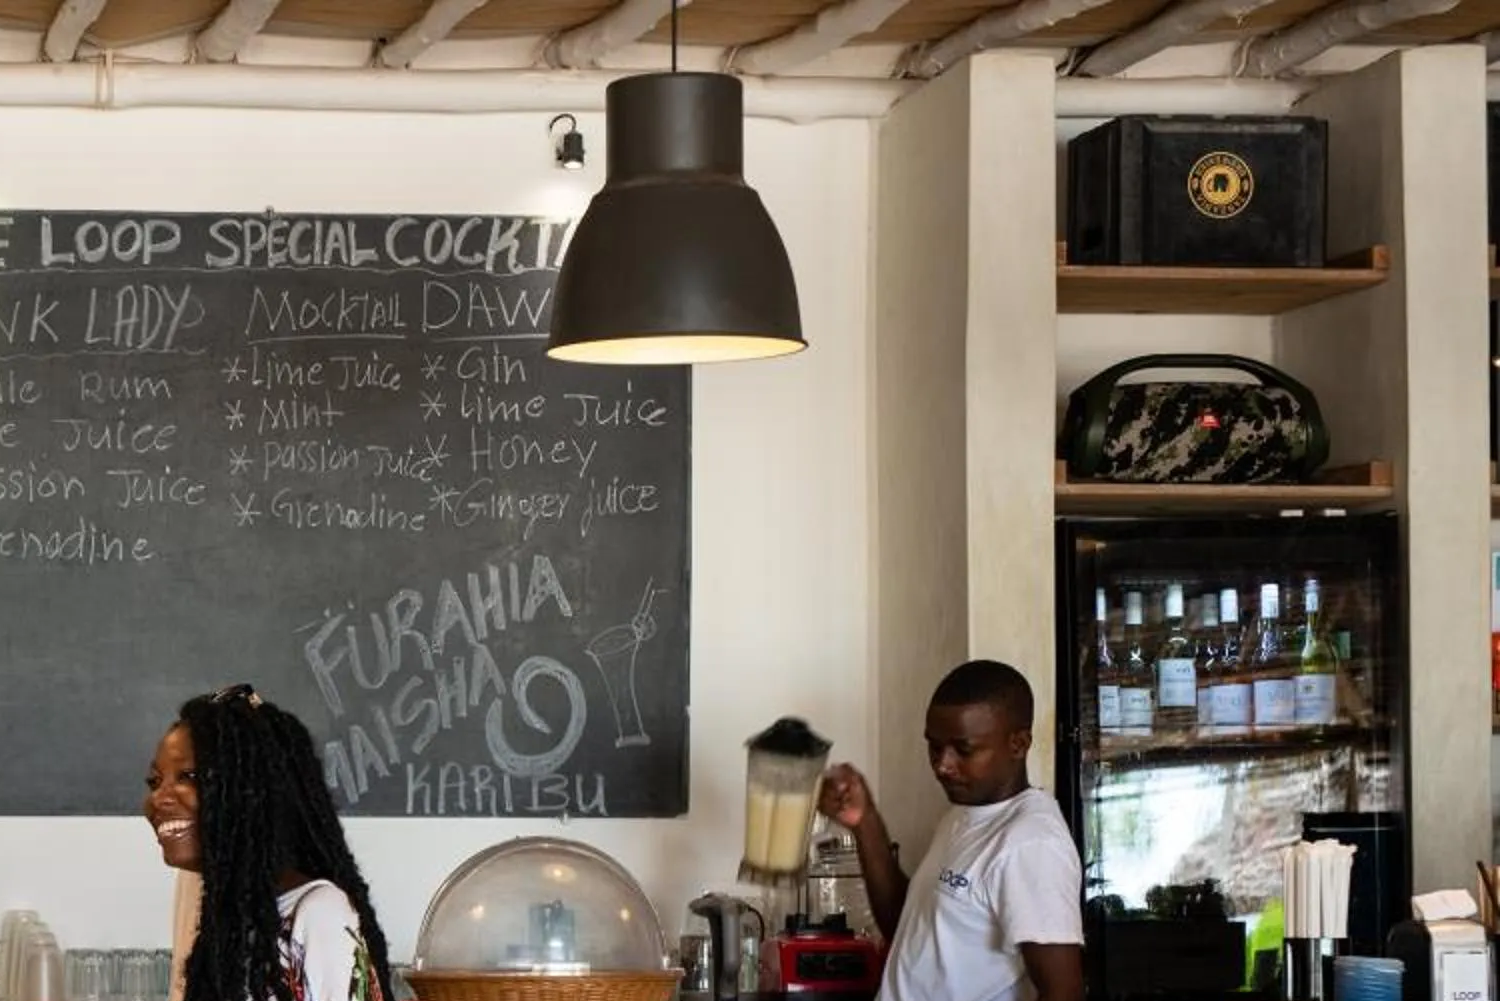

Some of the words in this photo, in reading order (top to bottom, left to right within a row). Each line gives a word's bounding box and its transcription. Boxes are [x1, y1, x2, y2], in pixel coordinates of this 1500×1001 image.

[41, 217, 181, 267] LOOP
[205, 217, 376, 267] SPECIAL
[83, 284, 206, 352] LADY
[422, 280, 551, 333] DAW
[252, 346, 325, 390] Lime
[329, 351, 401, 391] Juice
[457, 342, 526, 384] Gin
[80, 369, 172, 404] Rum
[460, 382, 546, 424] Lime
[50, 407, 178, 453] Juice
[257, 389, 345, 435] Mint
[470, 423, 598, 478] Honey
[106, 465, 206, 508] Juice
[305, 554, 573, 718] FURAHIA
[406, 760, 609, 816] KARIBU
[1452, 991, 1482, 1001] LOOP
